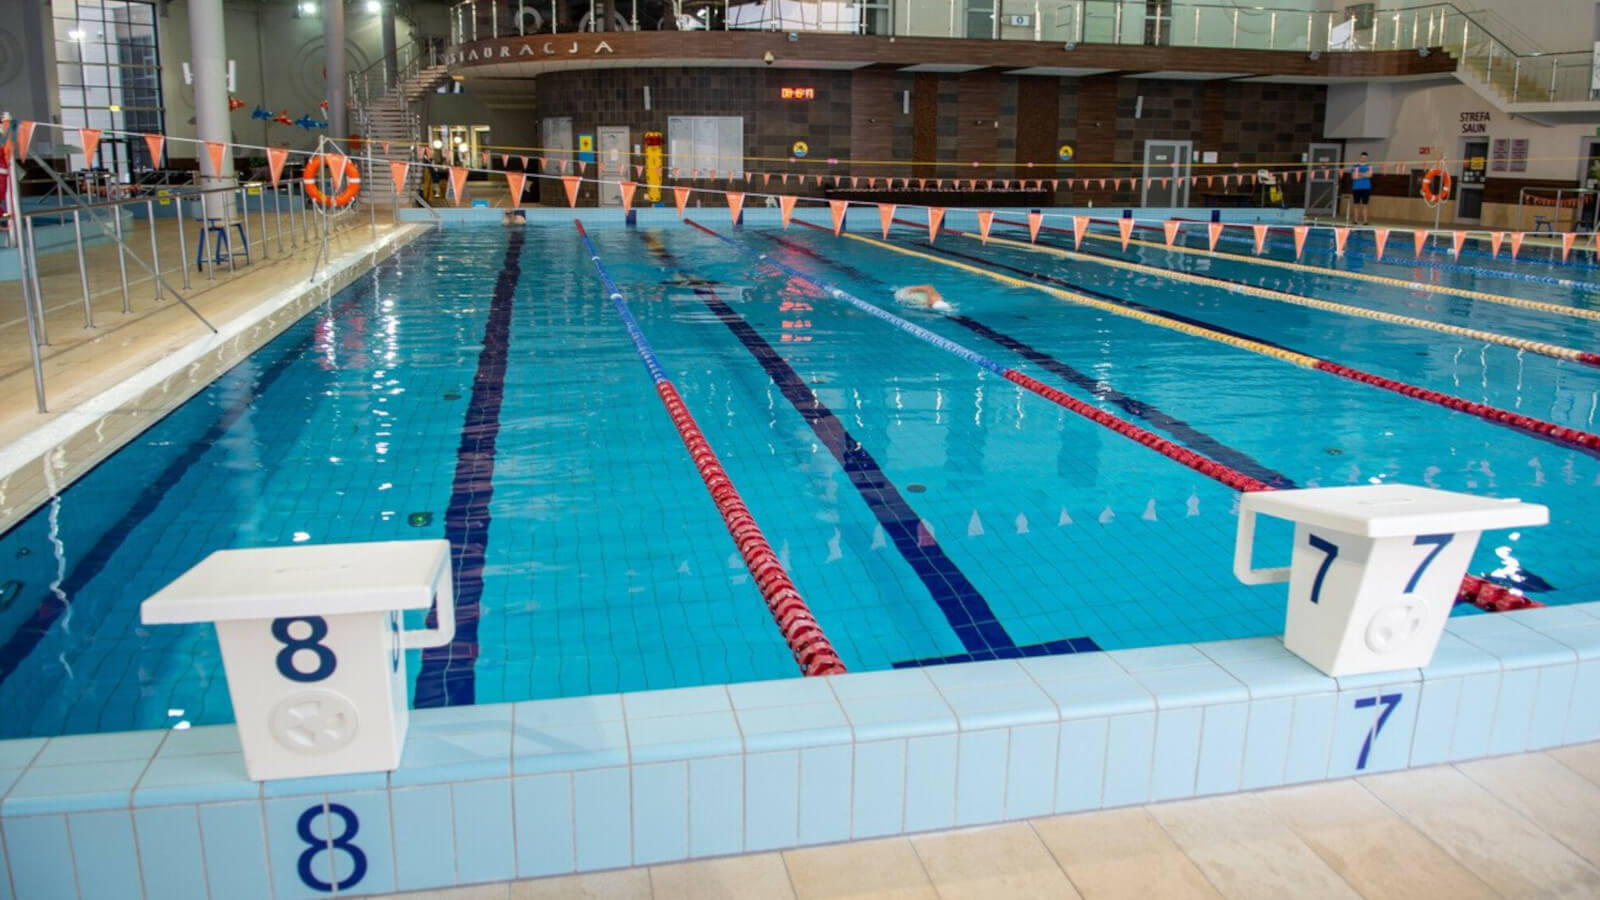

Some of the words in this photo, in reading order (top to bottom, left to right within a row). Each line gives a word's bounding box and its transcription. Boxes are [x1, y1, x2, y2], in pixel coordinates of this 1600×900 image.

[1460, 111, 1490, 122] STREFA
[1308, 533, 1339, 605] 7
[1403, 533, 1455, 594] 7
[271, 615, 337, 683] 8
[1354, 693, 1403, 770] 7
[296, 803, 368, 892] 8
